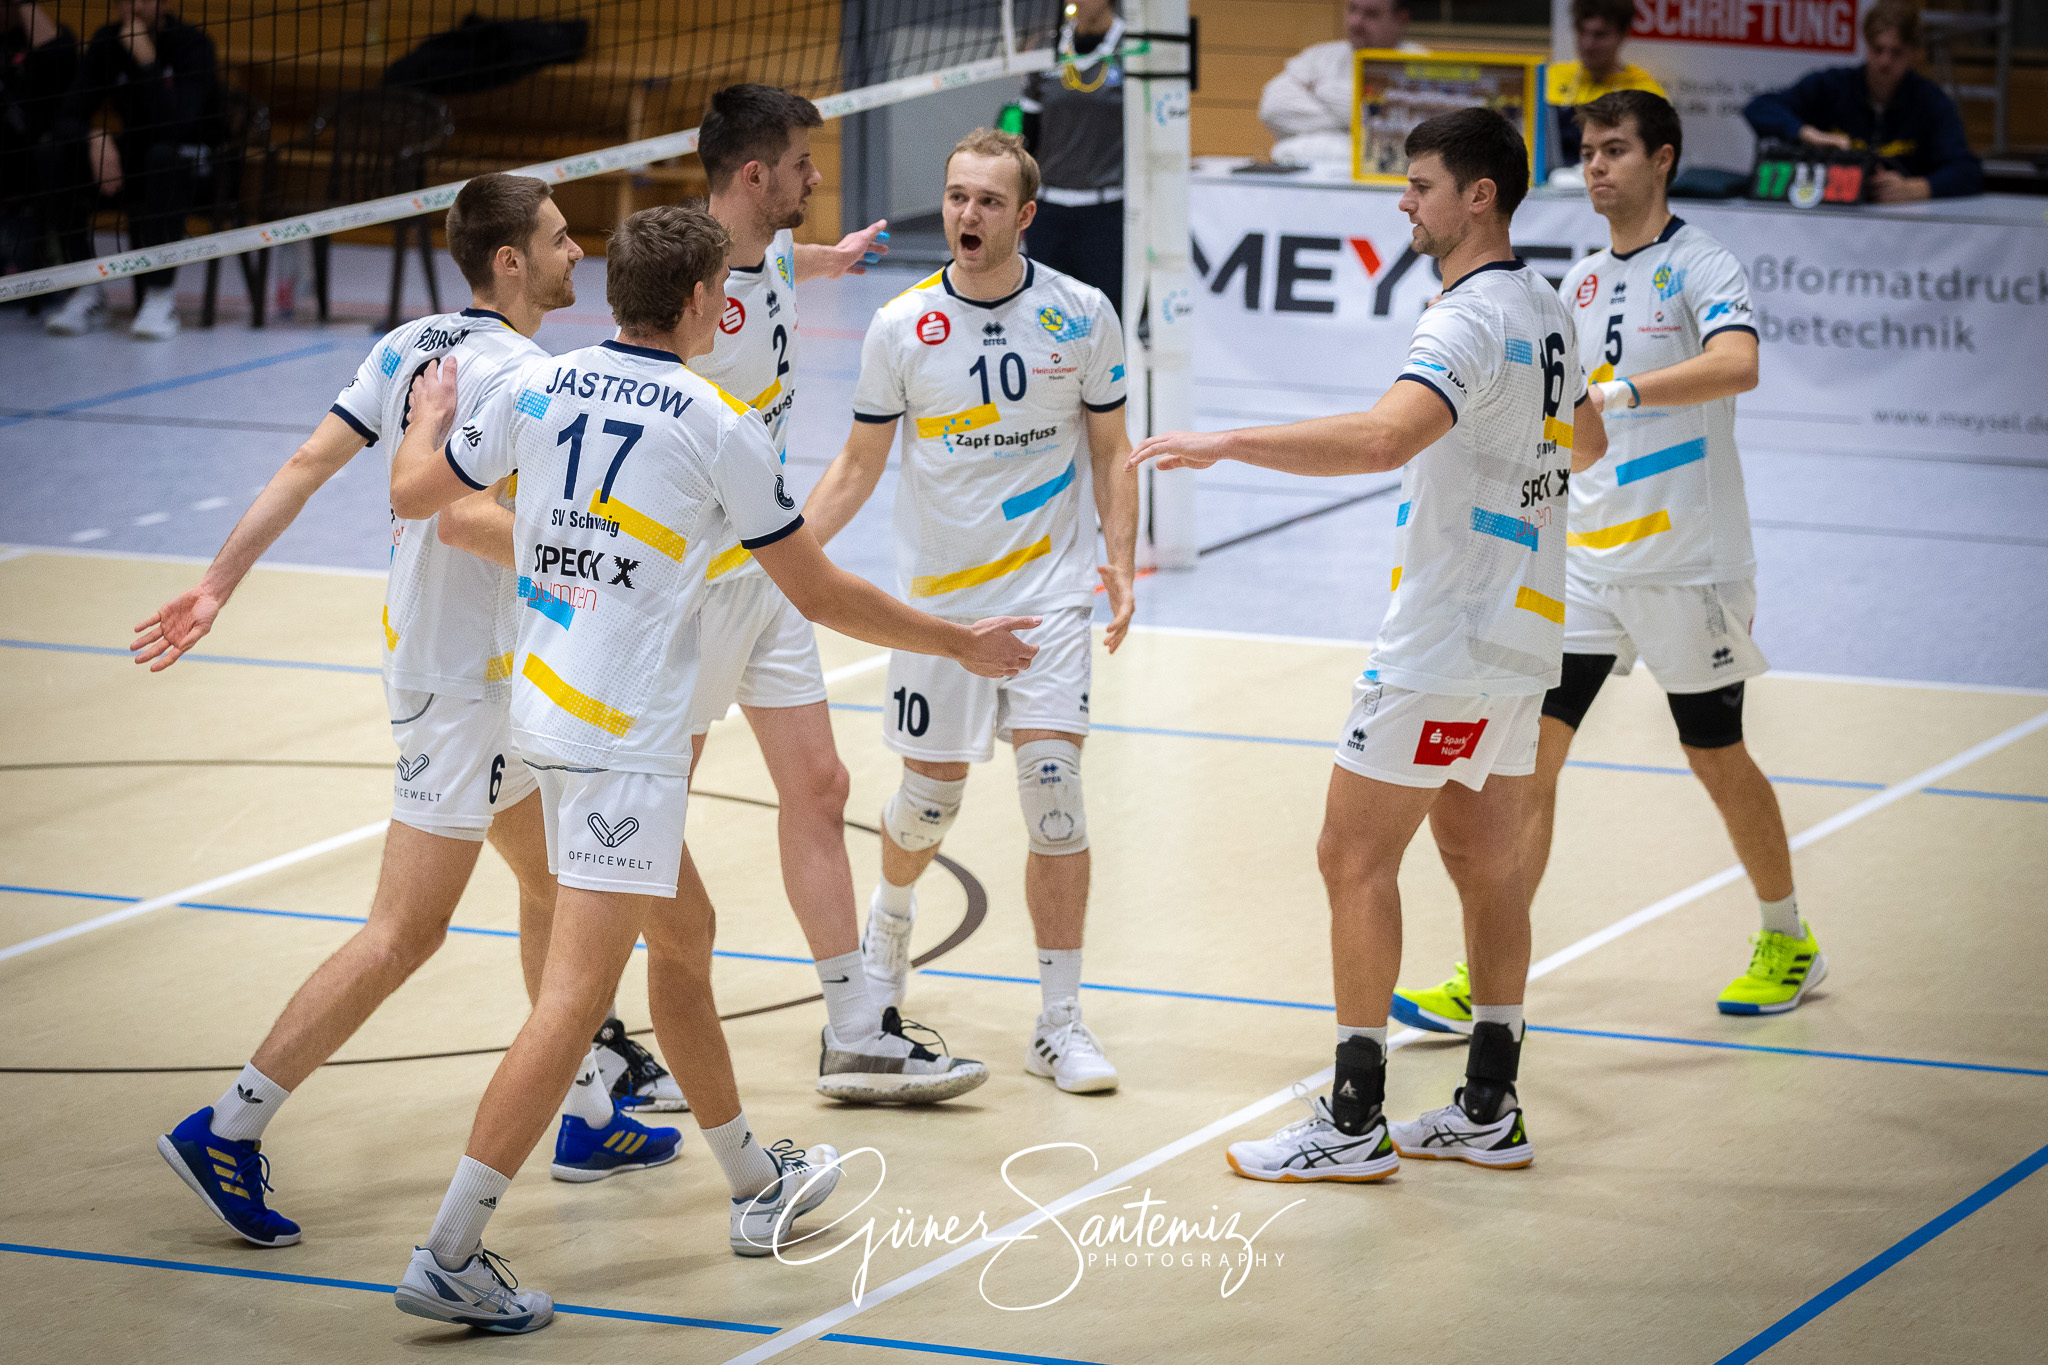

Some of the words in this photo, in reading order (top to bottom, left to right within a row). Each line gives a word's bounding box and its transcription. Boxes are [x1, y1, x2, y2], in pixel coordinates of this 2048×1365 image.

[772, 324, 790, 377] 2
[1605, 314, 1624, 366] 5
[546, 367, 694, 418] JASTROW
[969, 352, 1027, 405] 10
[556, 412, 644, 504] 17
[956, 434, 990, 449] Zapf
[994, 425, 1057, 446] Daigfuss
[551, 508, 565, 527] SV
[569, 510, 620, 537] Schwaig
[534, 543, 605, 581] SPECK
[527, 579, 597, 611] pumpen
[893, 686, 930, 737] 10
[489, 753, 505, 804] 6
[568, 850, 653, 871] OFFICEWELT
